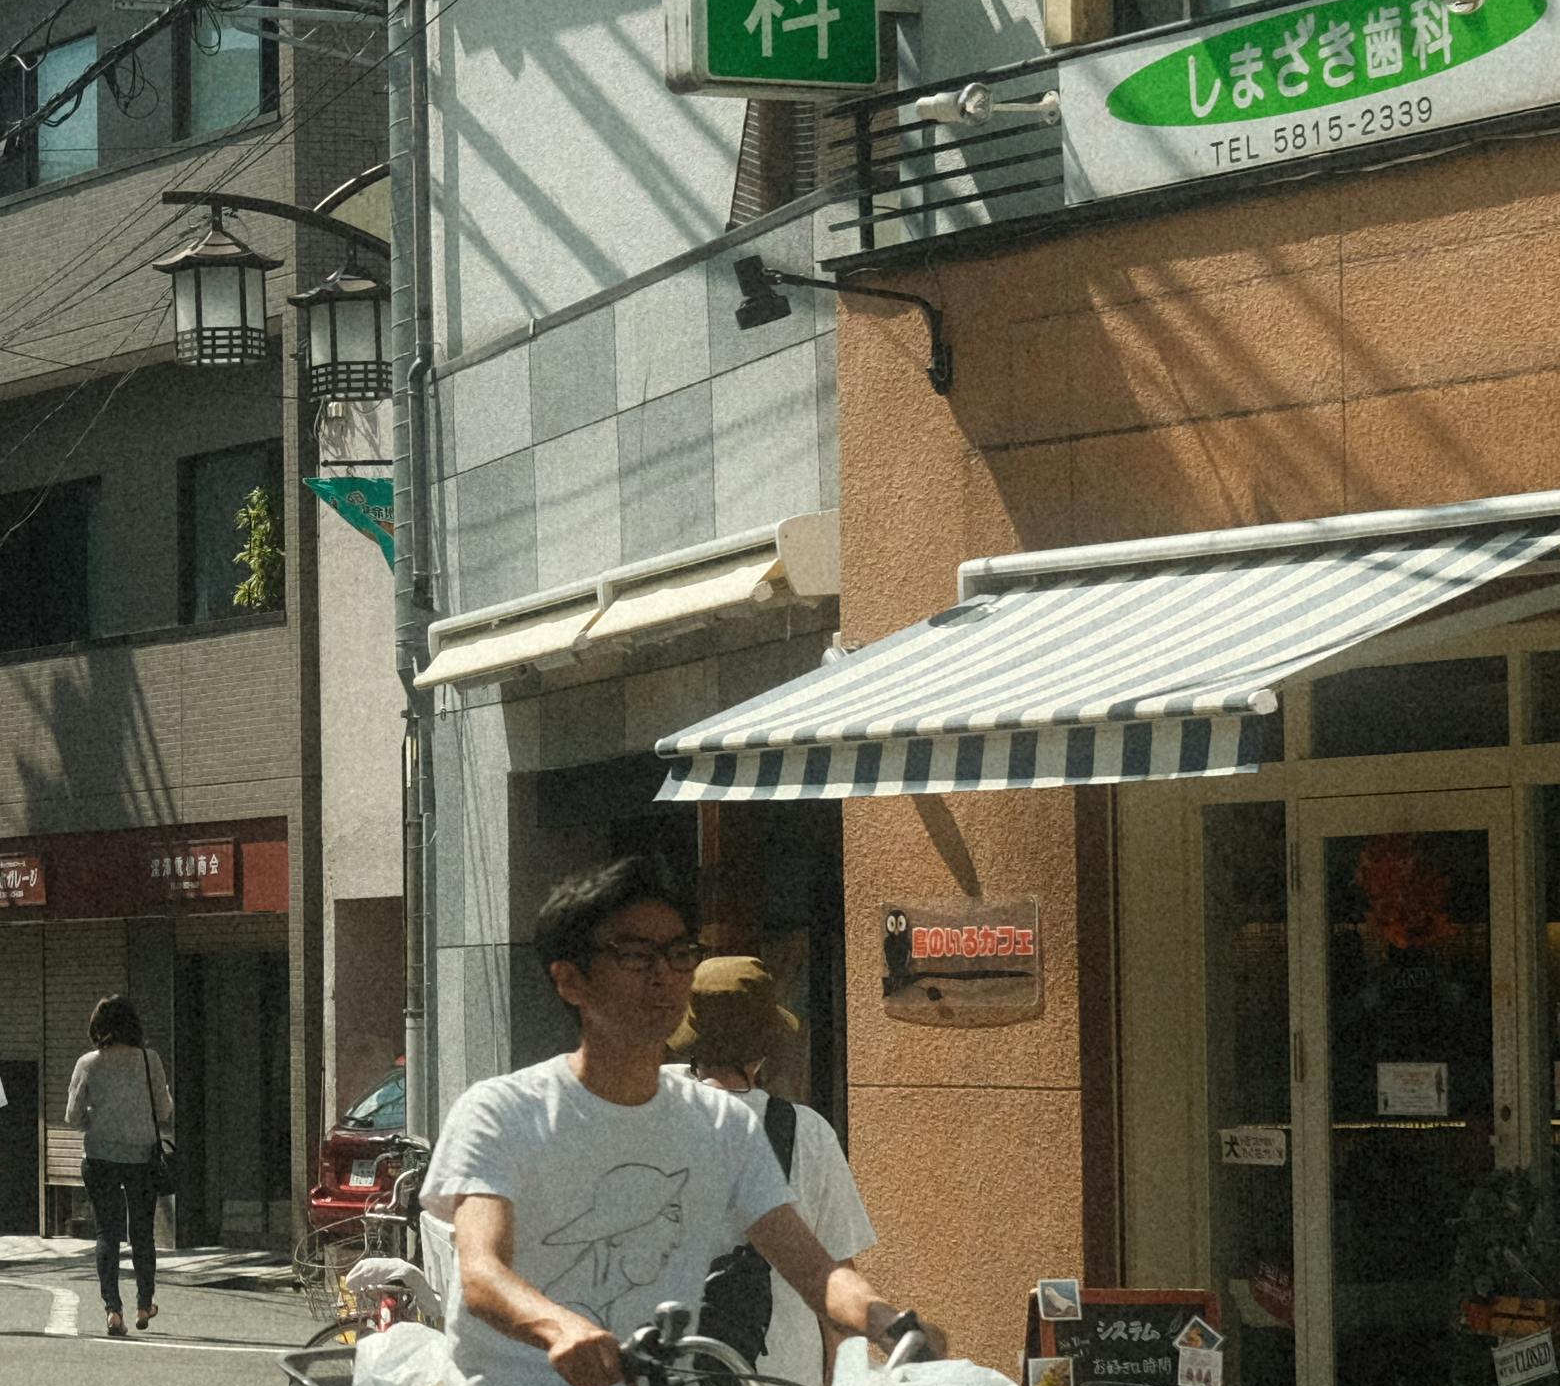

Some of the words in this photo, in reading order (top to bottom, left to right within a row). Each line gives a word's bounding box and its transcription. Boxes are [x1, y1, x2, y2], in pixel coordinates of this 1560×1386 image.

[1187, 0, 1455, 122] しまざき歯科
[1210, 135, 1260, 170] TEL
[1272, 96, 1435, 156] 5815-2339
[911, 926, 1034, 959] 鳥のいるカフェ
[1096, 1320, 1161, 1342] システム
[1514, 1342, 1552, 1373] CLOSED
